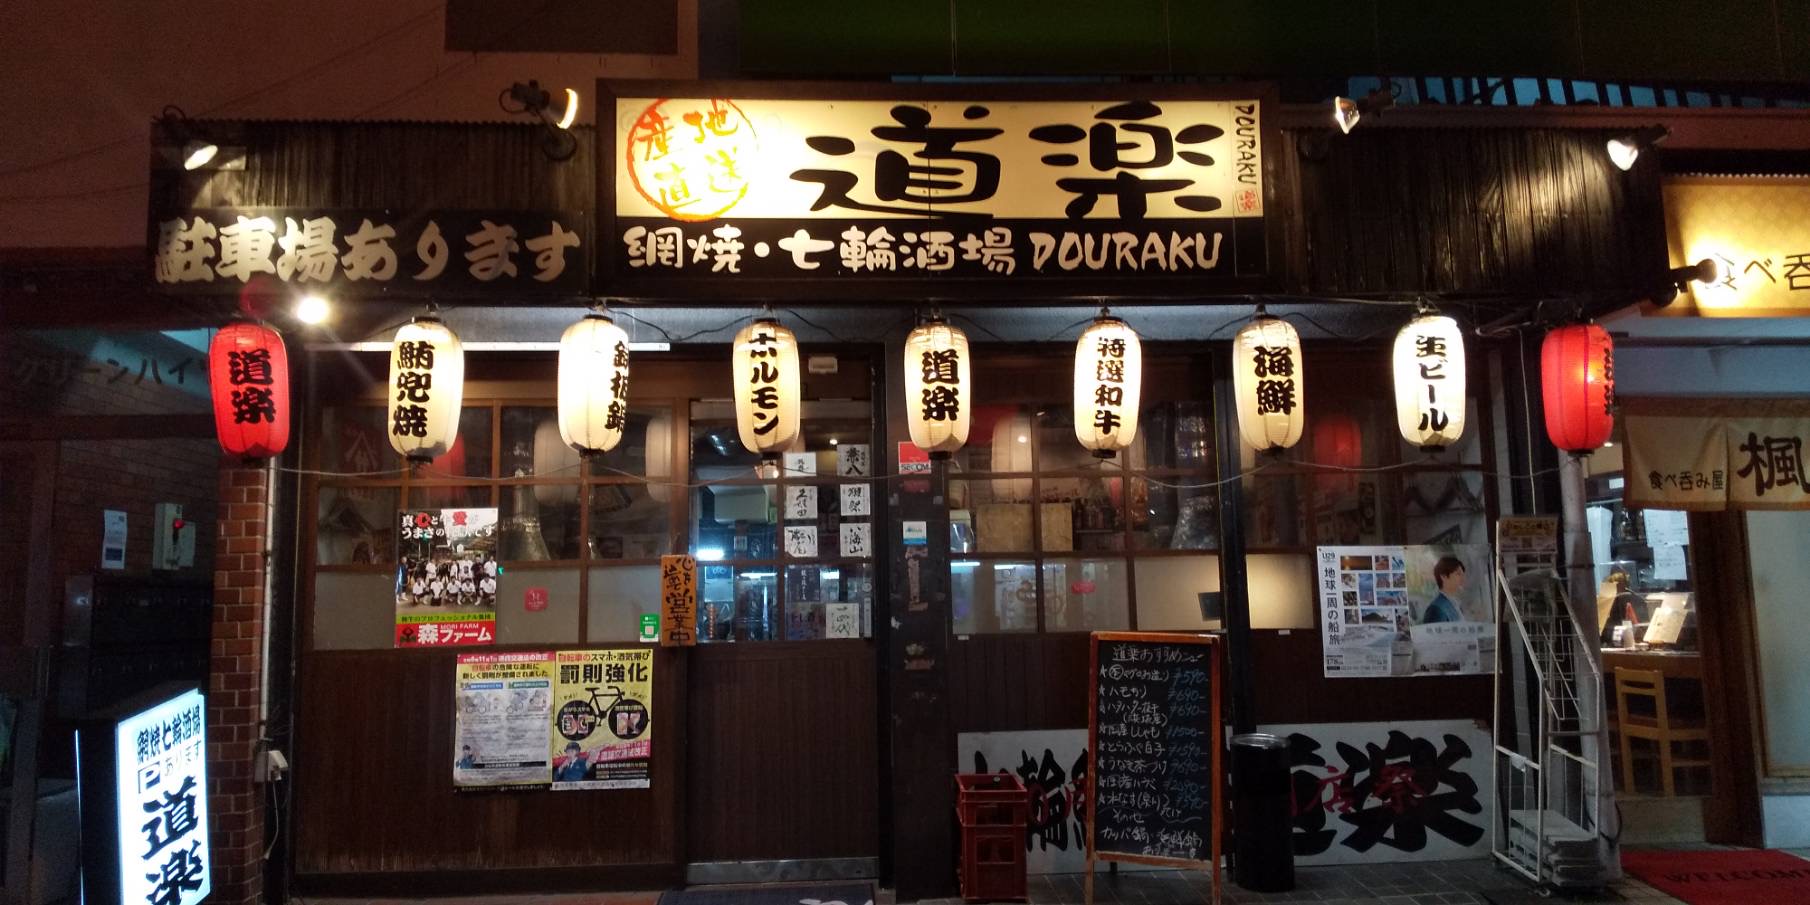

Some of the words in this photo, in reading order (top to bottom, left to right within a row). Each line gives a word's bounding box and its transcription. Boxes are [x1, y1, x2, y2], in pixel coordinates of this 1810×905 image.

[789, 102, 1225, 219] 道楽
[1234, 103, 1257, 185] DOURAKU
[155, 215, 581, 284] 駐車場あります
[623, 223, 1016, 276] 網焼・七輪酒場
[1030, 230, 1224, 271] DOURAKU
[228, 348, 276, 424] 道楽
[392, 341, 436, 438] 鮪兜焼
[748, 331, 780, 436] ホルモン
[921, 349, 961, 422] 道楽
[1093, 336, 1127, 435] 特選和牛
[1253, 345, 1298, 417] 海鮮
[1415, 335, 1449, 433] 生ビール
[1648, 470, 1724, 492] 食べ呑み屋
[417, 625, 492, 645] 森ファーム
[1323, 567, 1344, 646] 地球一周の船旅
[560, 662, 648, 684] 罰則強化
[141, 775, 204, 905] 道楽
